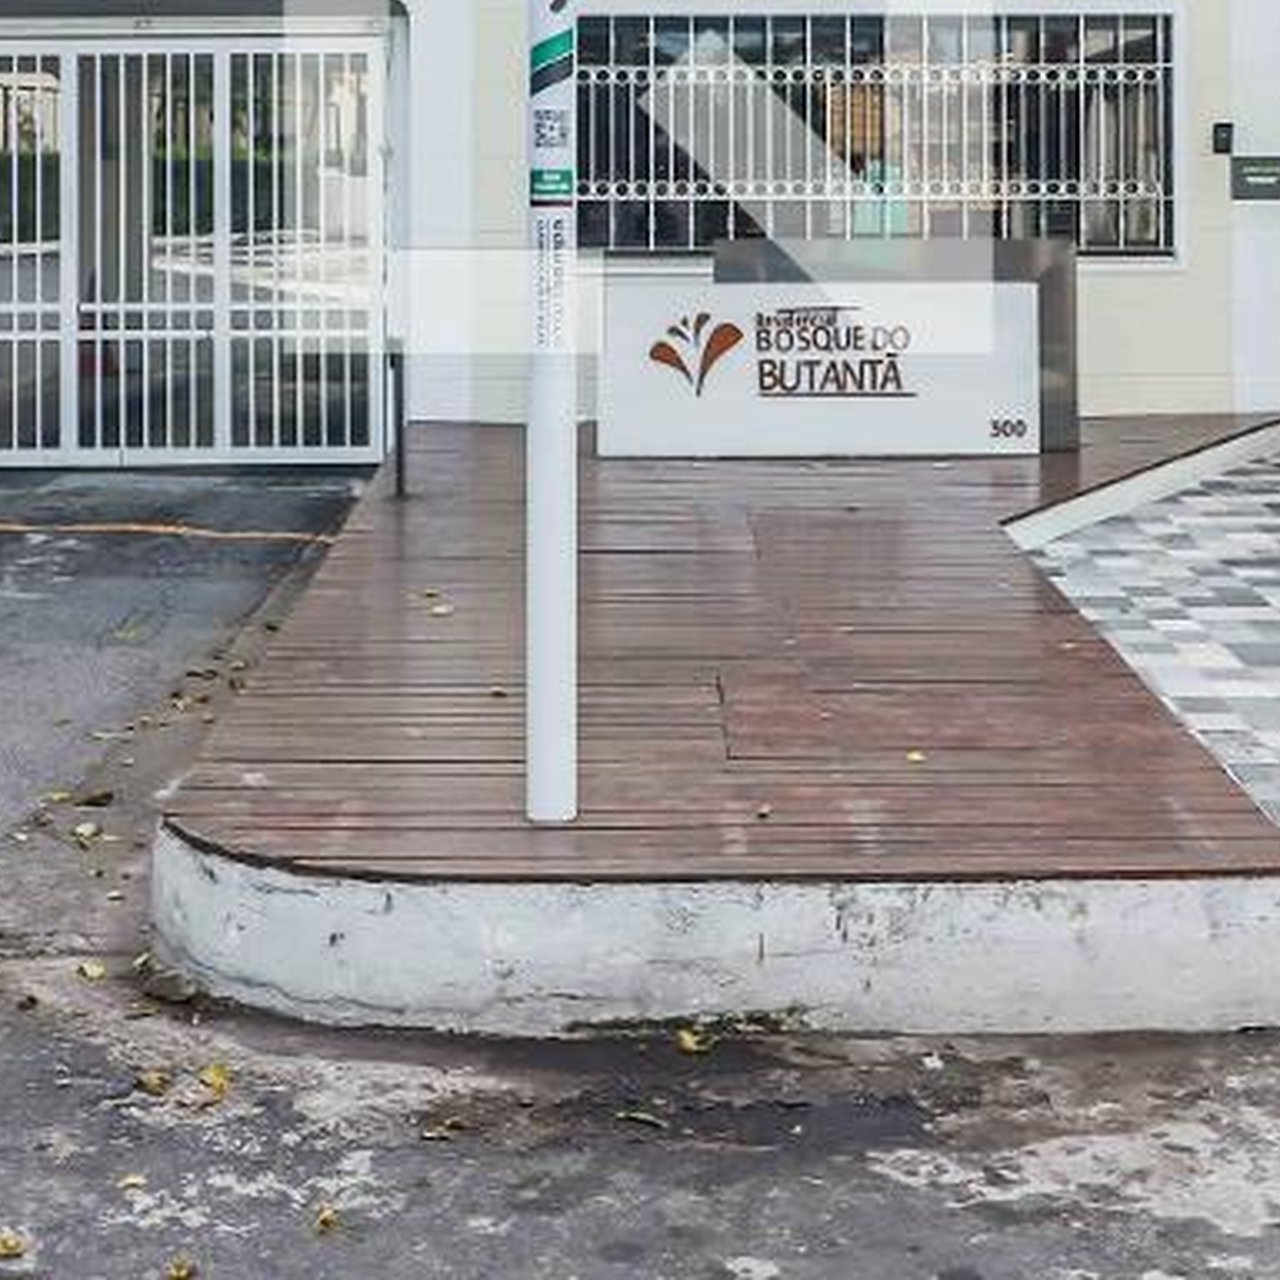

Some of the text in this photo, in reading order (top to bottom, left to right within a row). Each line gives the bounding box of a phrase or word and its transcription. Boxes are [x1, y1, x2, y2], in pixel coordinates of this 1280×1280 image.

[755, 326, 910, 352] BOSQUE DO
[757, 352, 903, 391] BUTANTÃ
[990, 419, 1028, 439] 500
